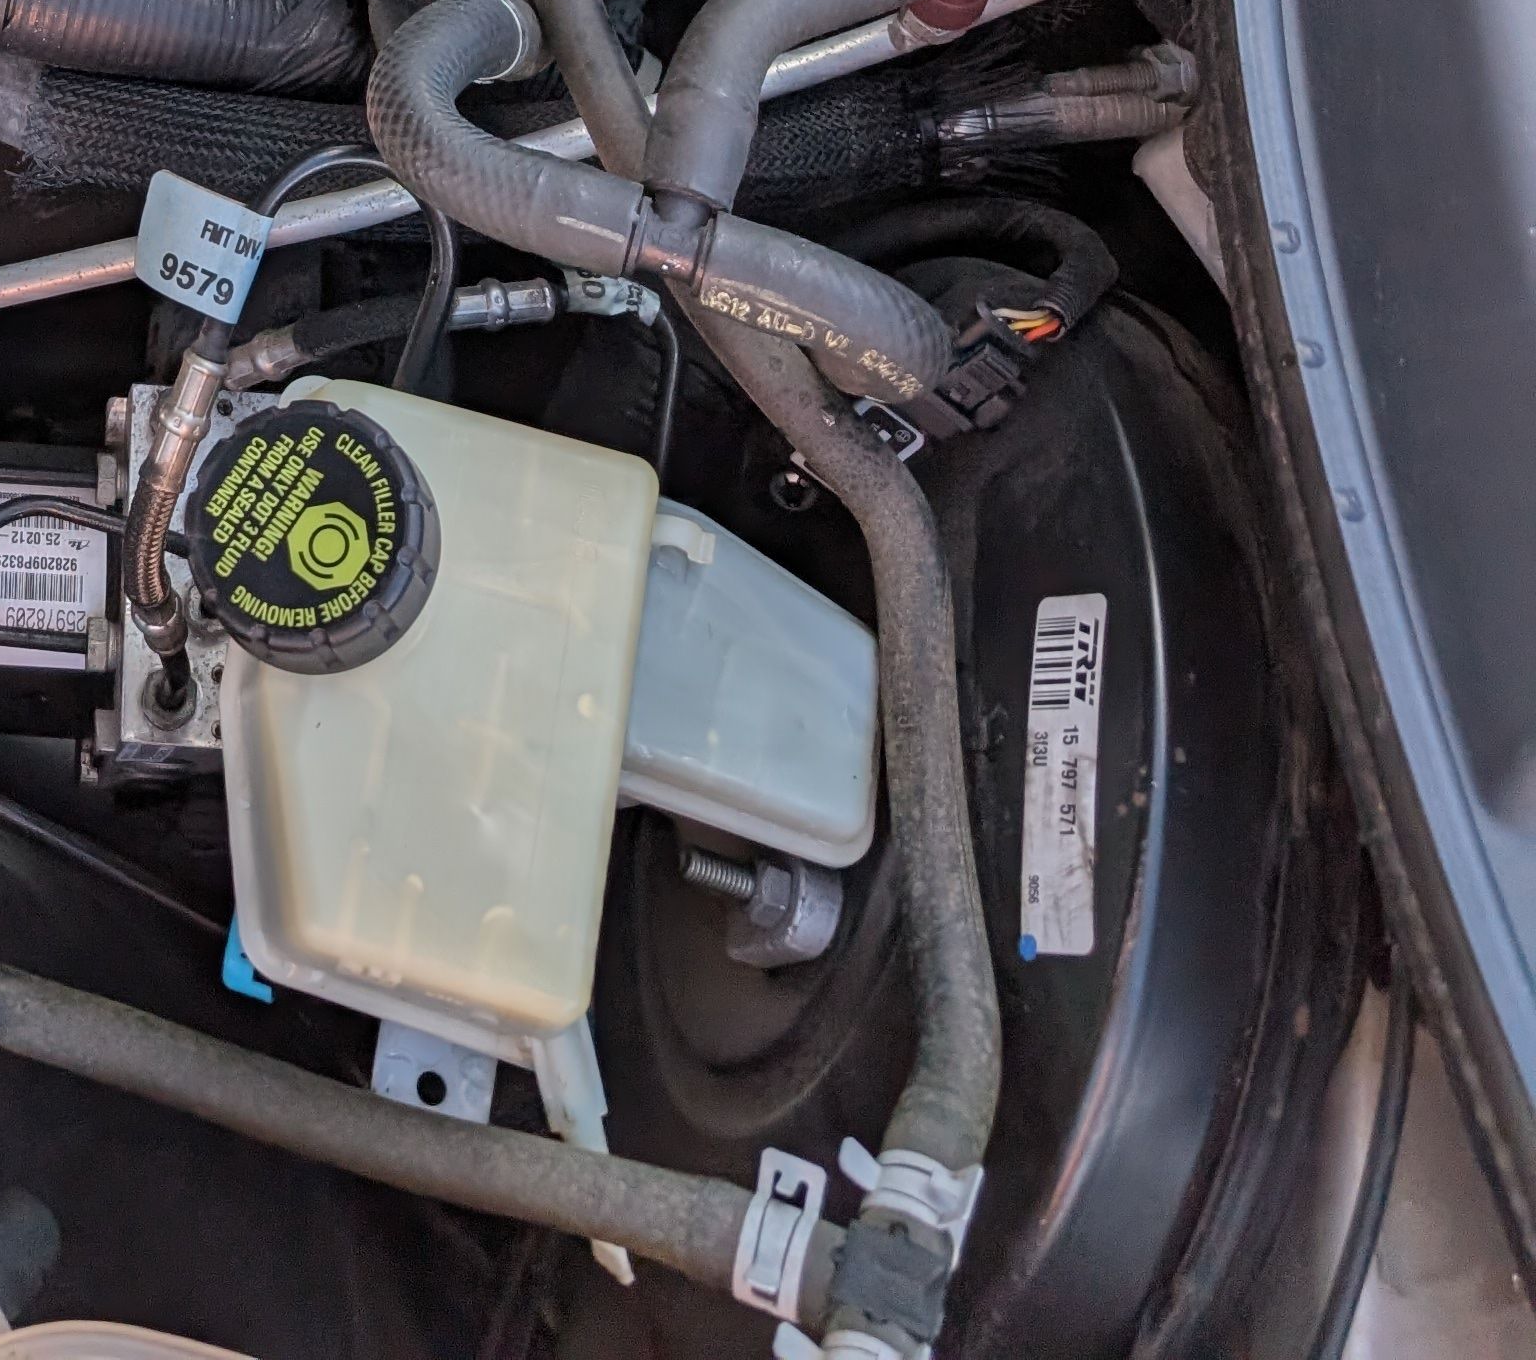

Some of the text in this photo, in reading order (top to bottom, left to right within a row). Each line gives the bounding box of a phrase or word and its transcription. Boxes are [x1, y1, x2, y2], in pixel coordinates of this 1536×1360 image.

[159, 252, 235, 305] 9579
[200, 219, 235, 248] FMT
[205, 436, 267, 518] CONTAINER
[212, 434, 294, 543] FROM A SEALED
[215, 426, 325, 578] USE ONLY DOT 3 FLUID
[251, 468, 324, 562] WARNING!
[230, 433, 396, 627] CLEAN FILLER CAP BEFORE REMOVING
[6, 606, 86, 632] 25978209
[1074, 618, 1099, 706] TRW
[1059, 726, 1079, 836] 15 797 571
